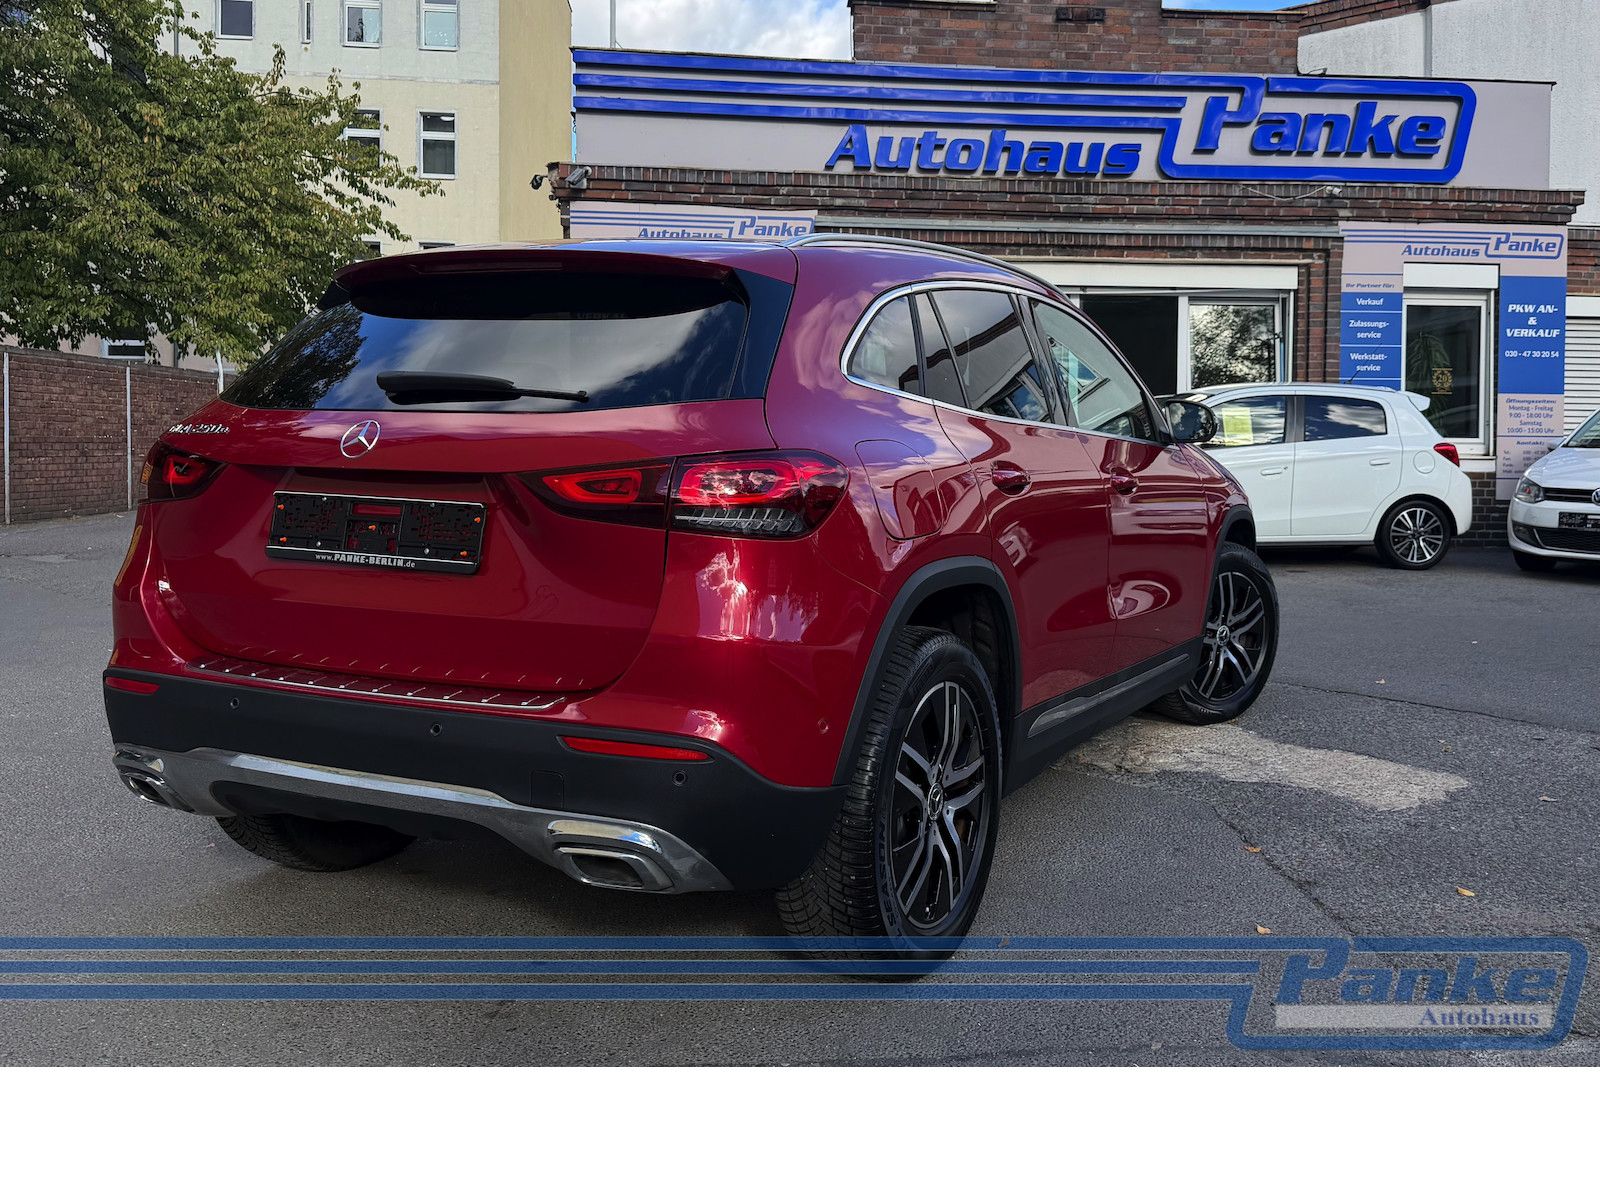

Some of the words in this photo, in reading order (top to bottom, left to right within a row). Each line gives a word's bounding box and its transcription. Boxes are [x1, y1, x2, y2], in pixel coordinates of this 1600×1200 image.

[825, 123, 1141, 177] Autohaus
[1192, 79, 1446, 157] Panke
[738, 216, 808, 238] Panke
[1401, 244, 1480, 257] Autohaus
[1494, 233, 1557, 253] Panke
[1356, 298, 1384, 306] Verkauf
[1507, 304, 1537, 313] PKW
[1536, 304, 1559, 313] AN-
[1349, 320, 1390, 329] Zulassungs-
[1527, 316, 1538, 326] &
[1357, 331, 1382, 339] service
[1506, 328, 1560, 338] VERKAUF
[1350, 352, 1388, 361] Werkstatt-
[1504, 350, 1518, 358] 030
[1522, 350, 1532, 358] 47
[1532, 350, 1541, 358] 30
[1541, 350, 1550, 358] 20
[1550, 350, 1559, 358] 54
[1356, 364, 1382, 372] service
[315, 553, 416, 569] www.PANKE-BERLIN.de
